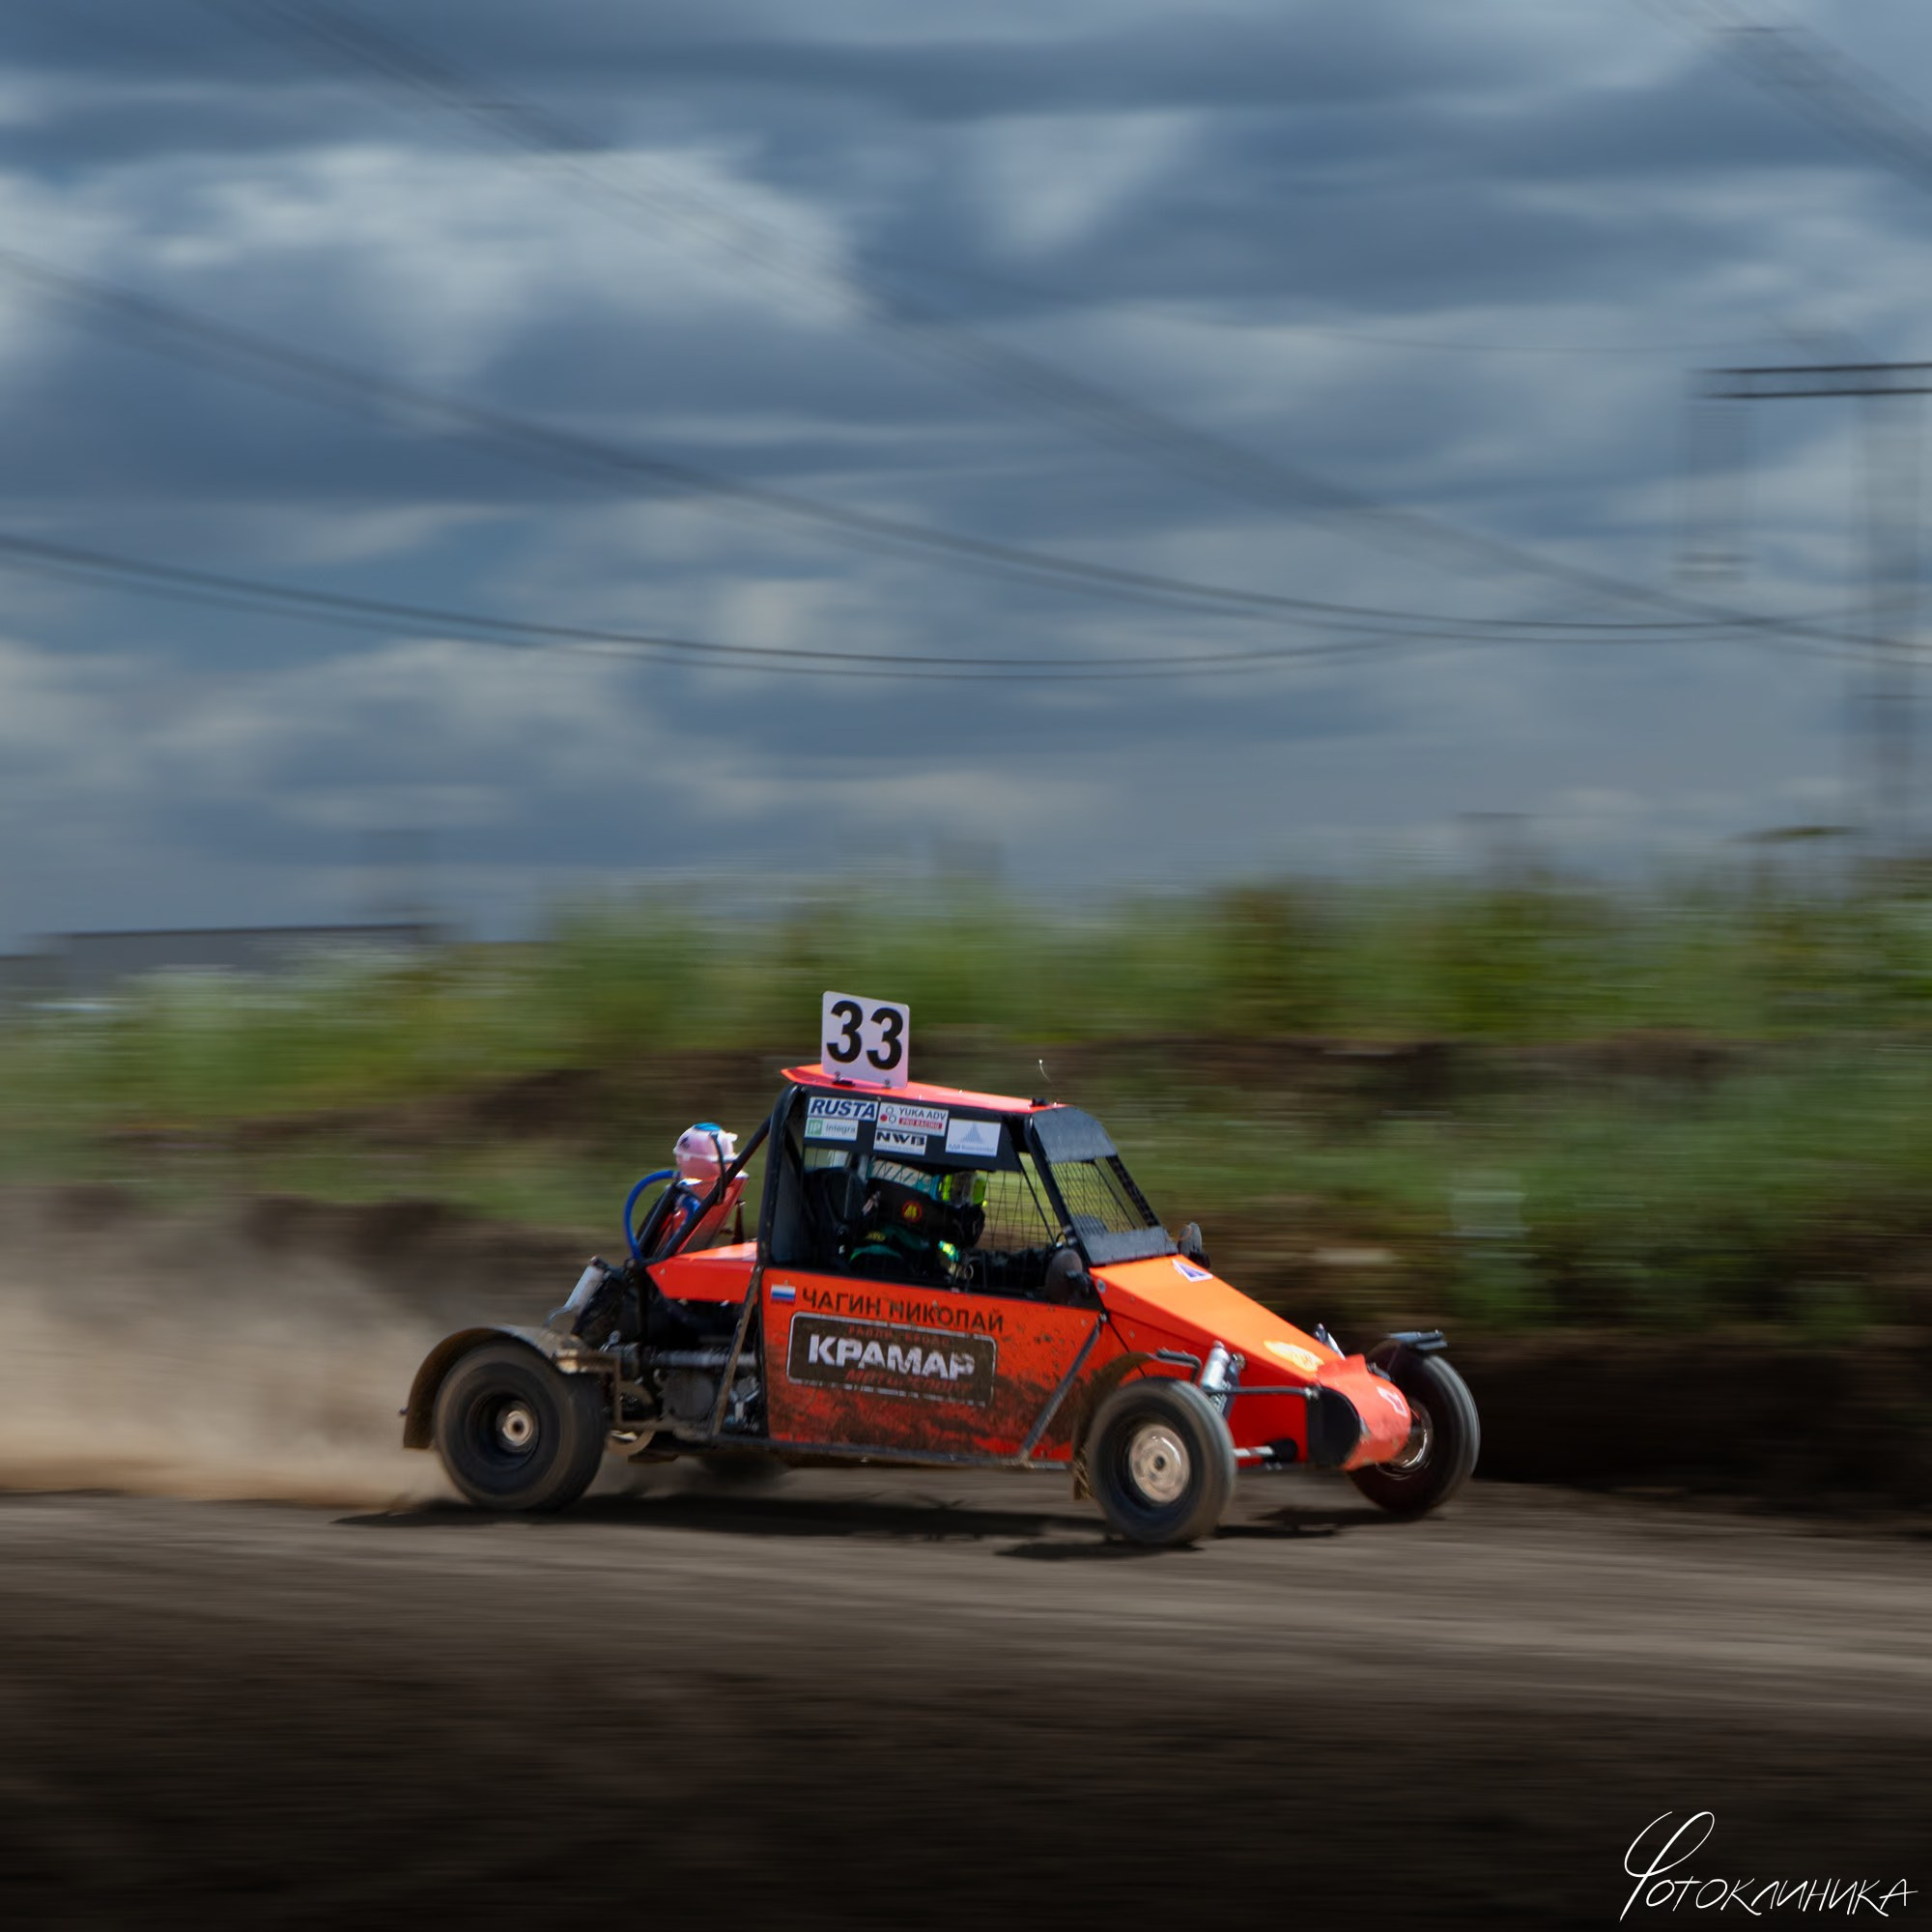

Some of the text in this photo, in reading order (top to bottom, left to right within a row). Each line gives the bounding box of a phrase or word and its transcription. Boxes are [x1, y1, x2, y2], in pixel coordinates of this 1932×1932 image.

[826, 1000, 904, 1071] 33
[810, 1099, 875, 1118] RUSTA
[899, 1107, 947, 1122] YUKA ADV
[802, 1288, 1004, 1333] ЧАГИН НИКОЛАЙ
[808, 1333, 976, 1381] КРАМАР
